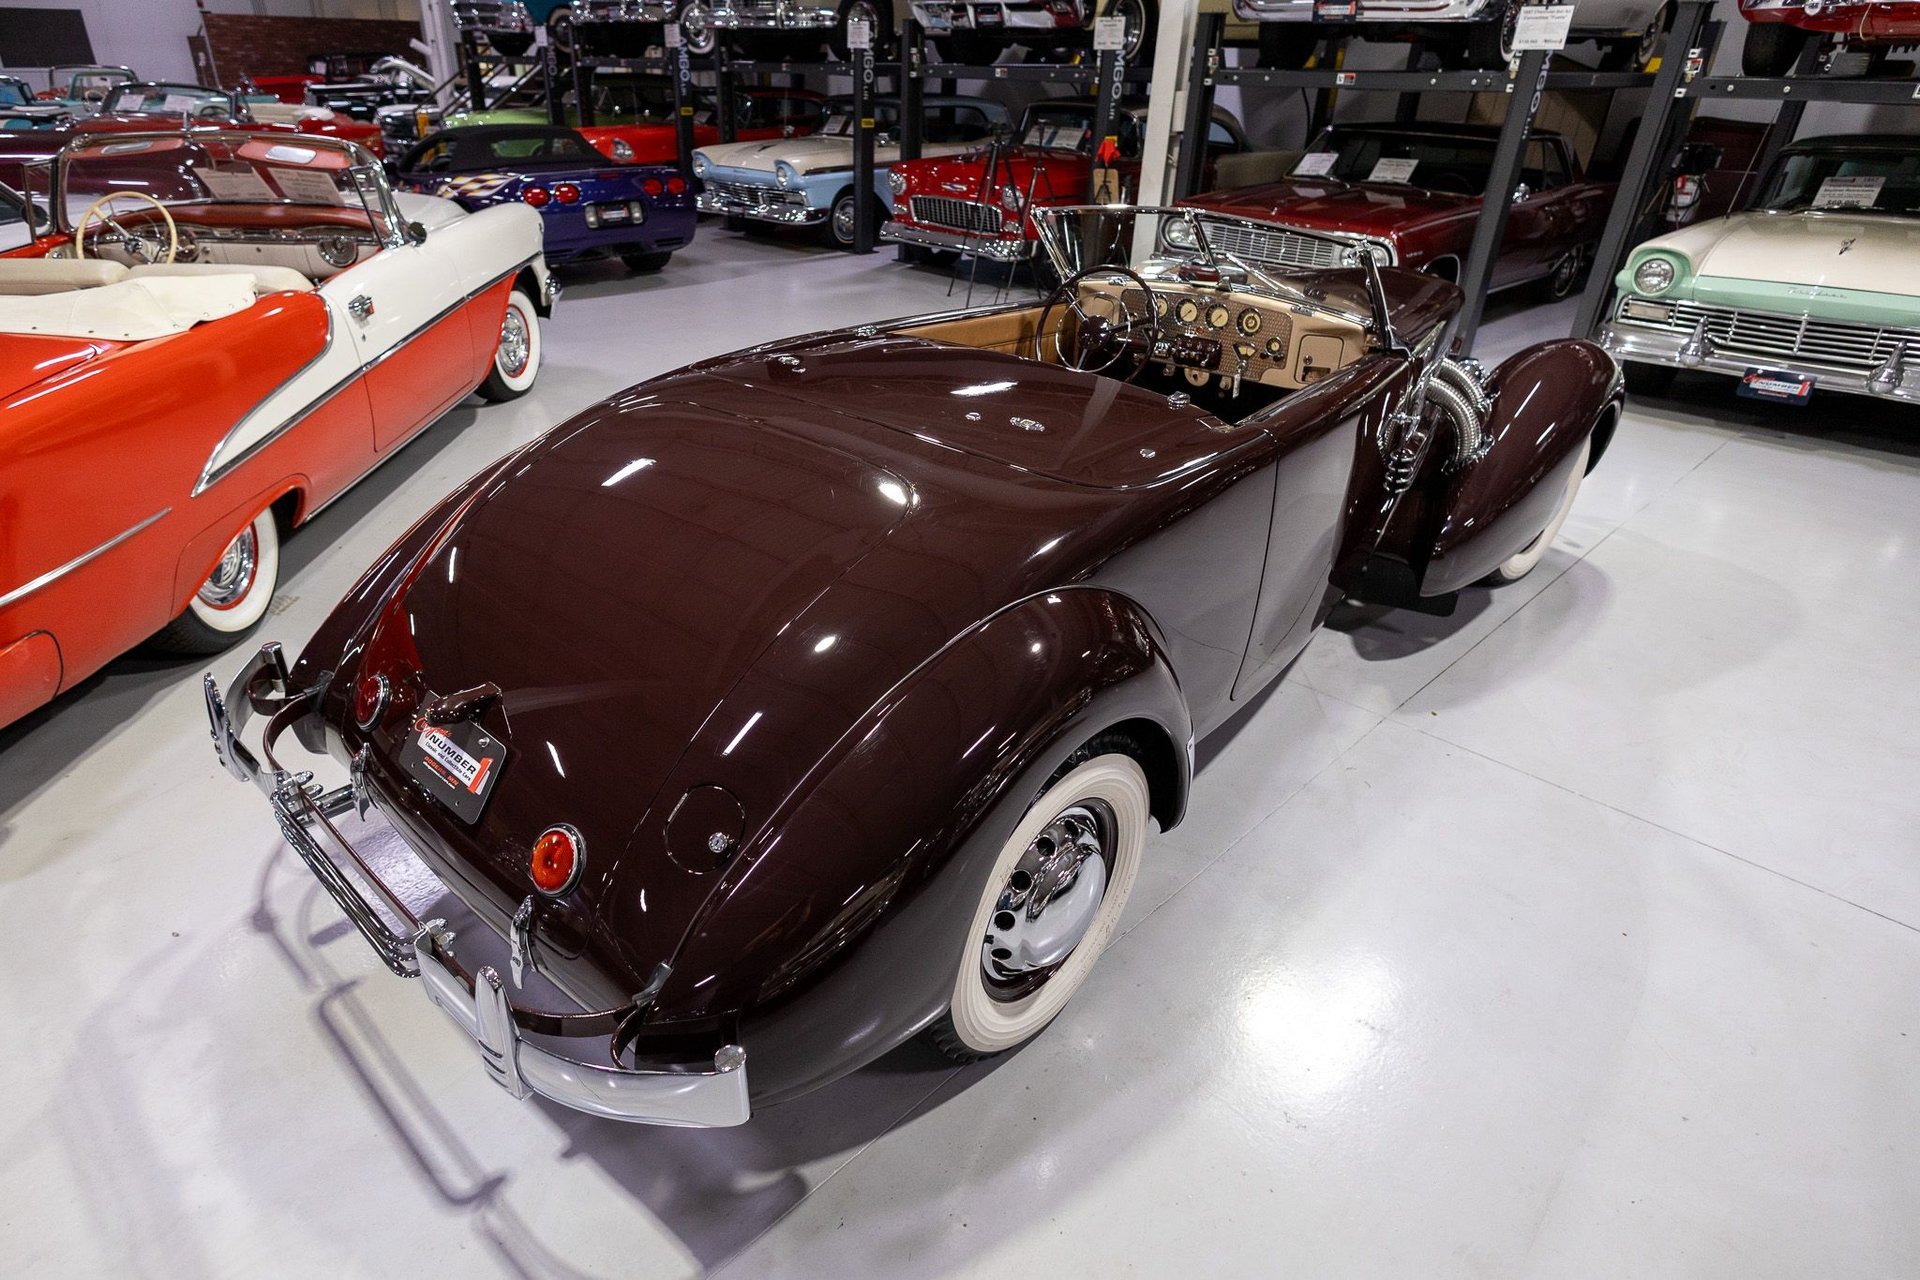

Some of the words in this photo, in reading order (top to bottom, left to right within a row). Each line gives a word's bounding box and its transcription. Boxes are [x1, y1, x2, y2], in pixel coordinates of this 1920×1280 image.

[677, 37, 691, 82] AMGO
[863, 32, 874, 83] MGO
[1111, 38, 1126, 99] MGO
[1530, 49, 1553, 113] MGO
[425, 741, 438, 754] Classic
[444, 754, 463, 775] Collectible
[462, 770, 472, 782] Cars
[429, 734, 477, 775] NUMBER
[467, 757, 494, 795] 1
[447, 775, 460, 786] MN
